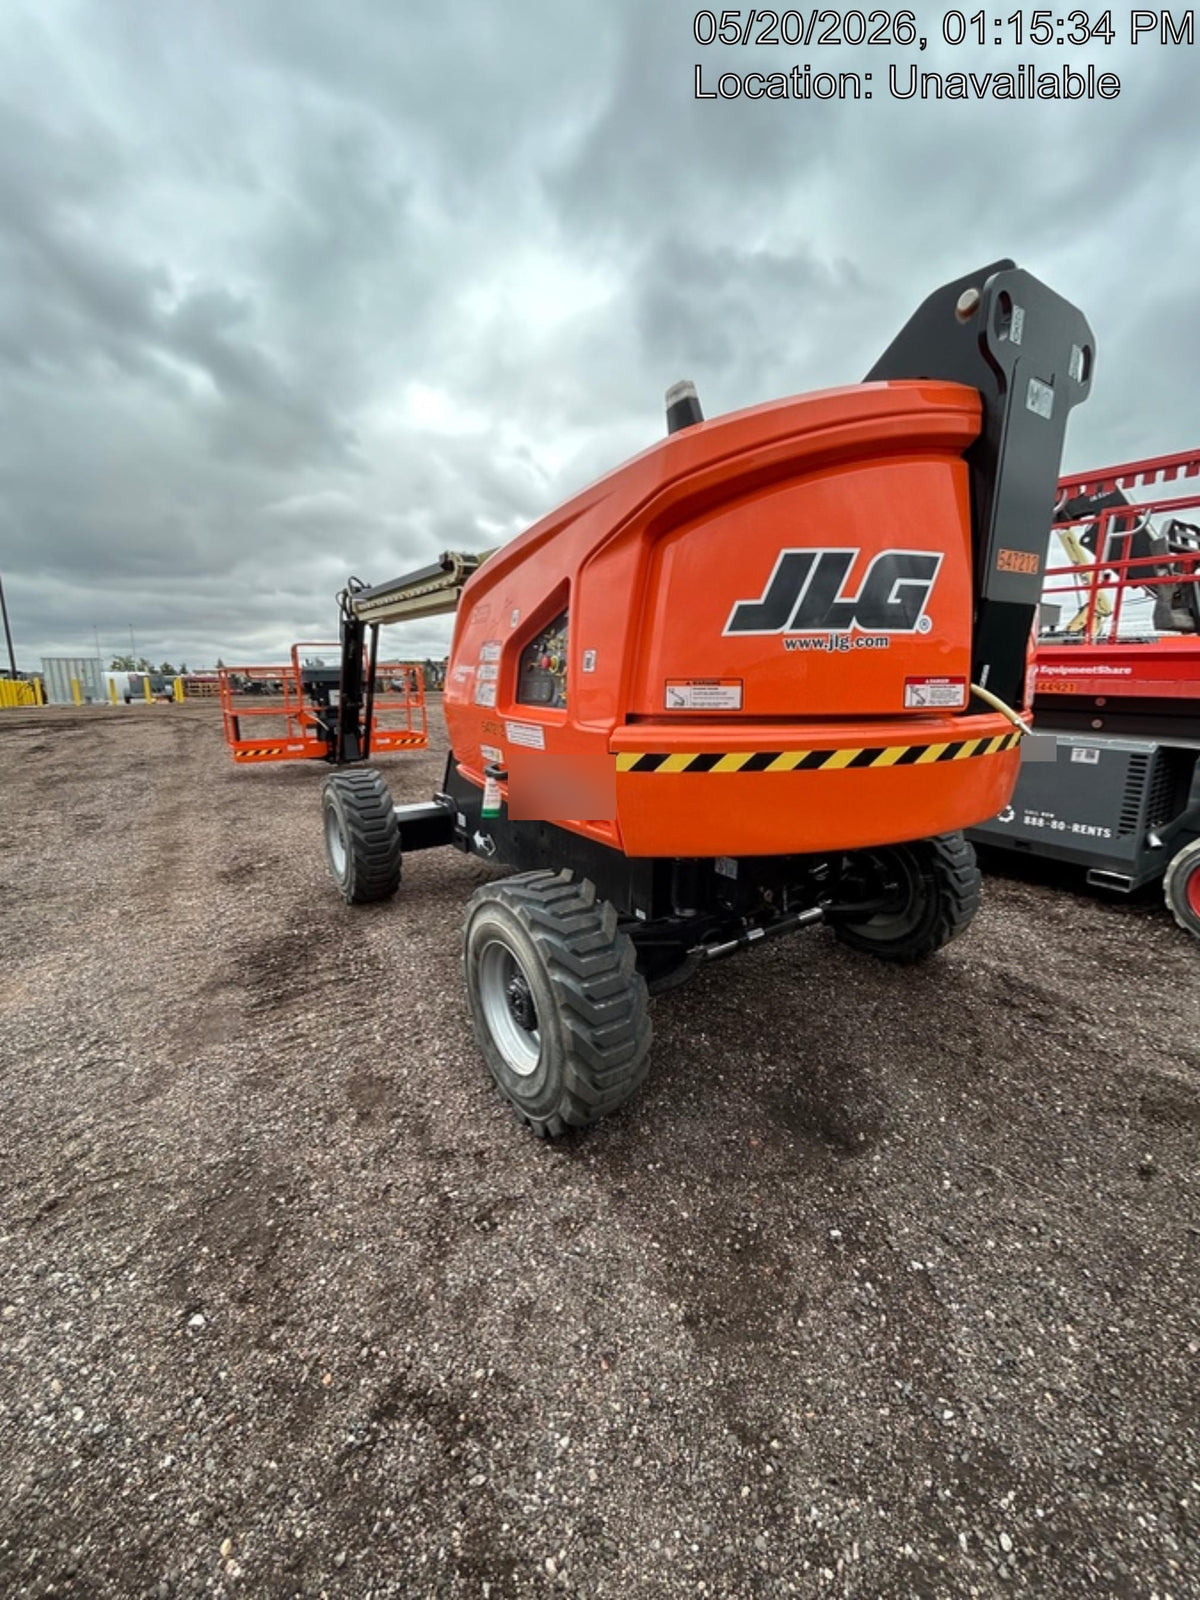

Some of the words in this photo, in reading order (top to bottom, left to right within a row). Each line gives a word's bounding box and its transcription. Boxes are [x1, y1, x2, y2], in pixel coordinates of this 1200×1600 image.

[783, 634, 889, 652] www.jlg.com
[1040, 665, 1132, 675] EquipmentShare
[1023, 815, 1112, 838] 888-80-RENTS
